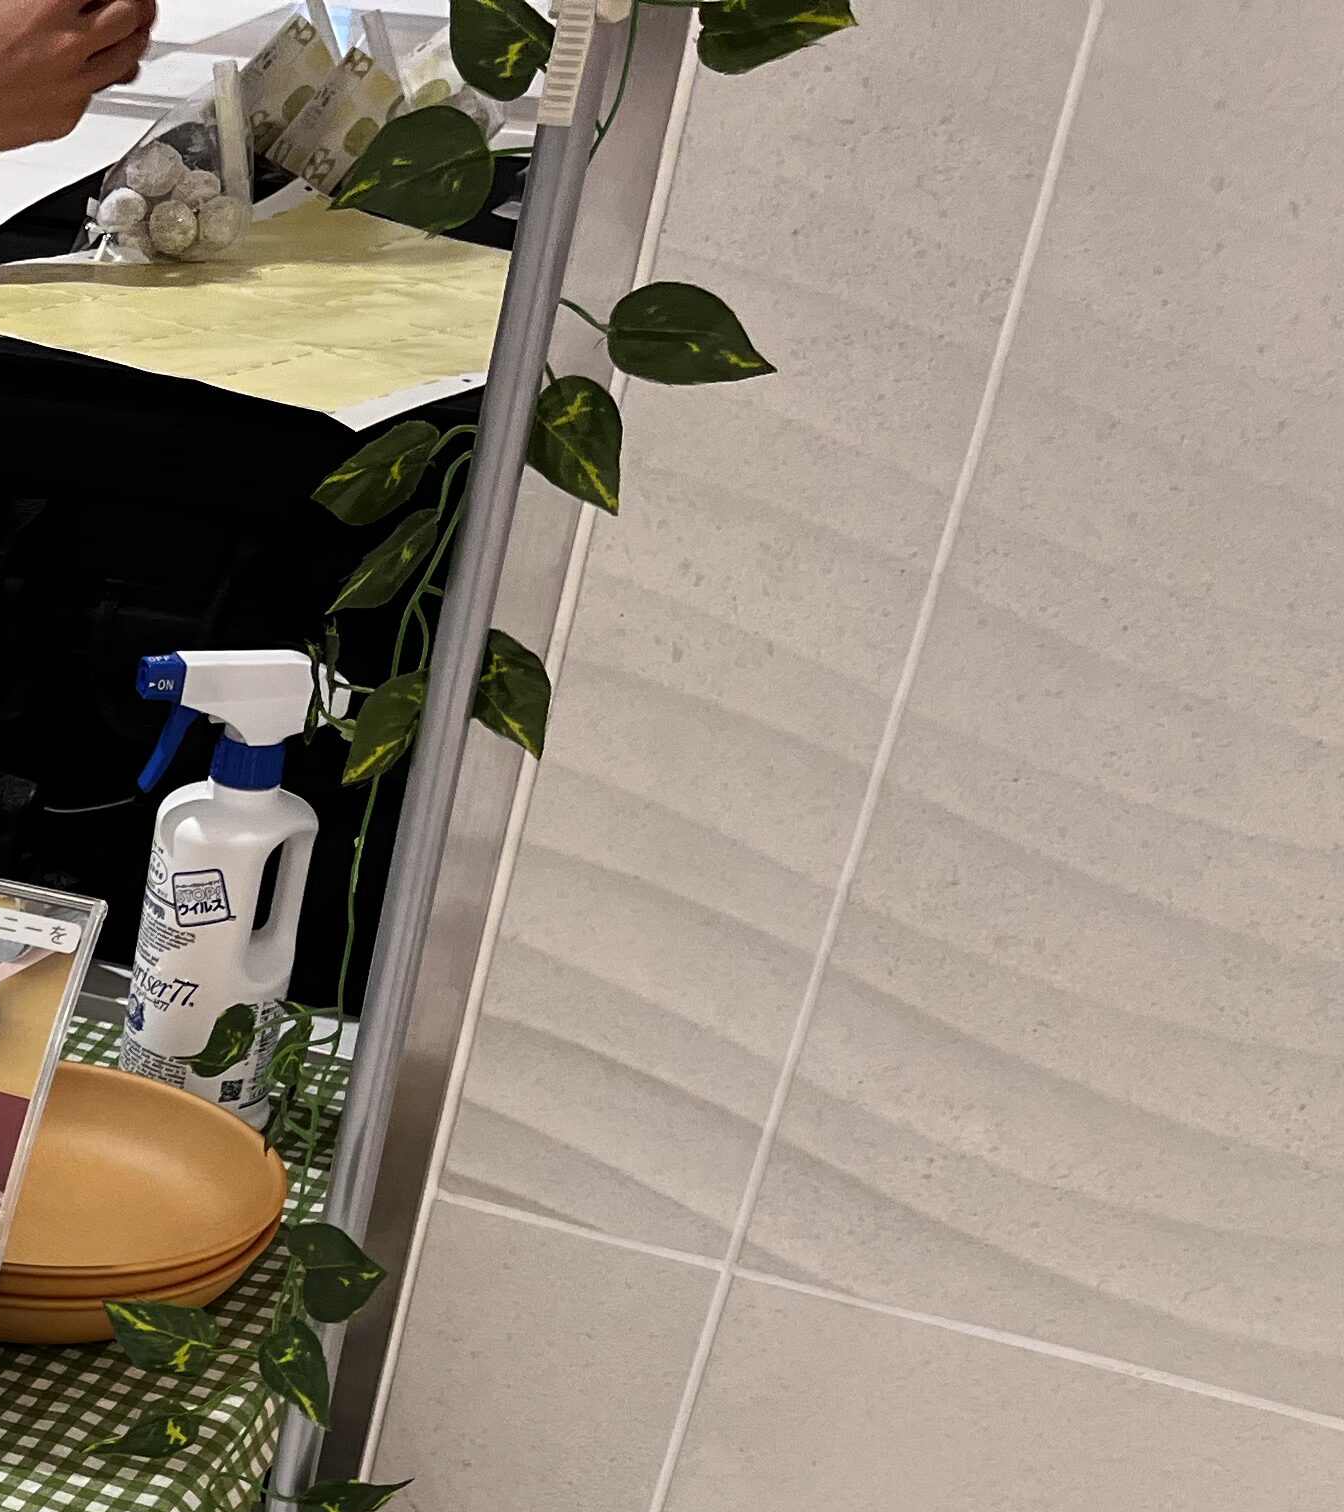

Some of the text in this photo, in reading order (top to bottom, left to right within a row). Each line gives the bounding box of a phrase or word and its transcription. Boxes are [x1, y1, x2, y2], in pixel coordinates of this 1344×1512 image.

[157, 679, 174, 691] ON
[179, 899, 225, 916] ウイルス
